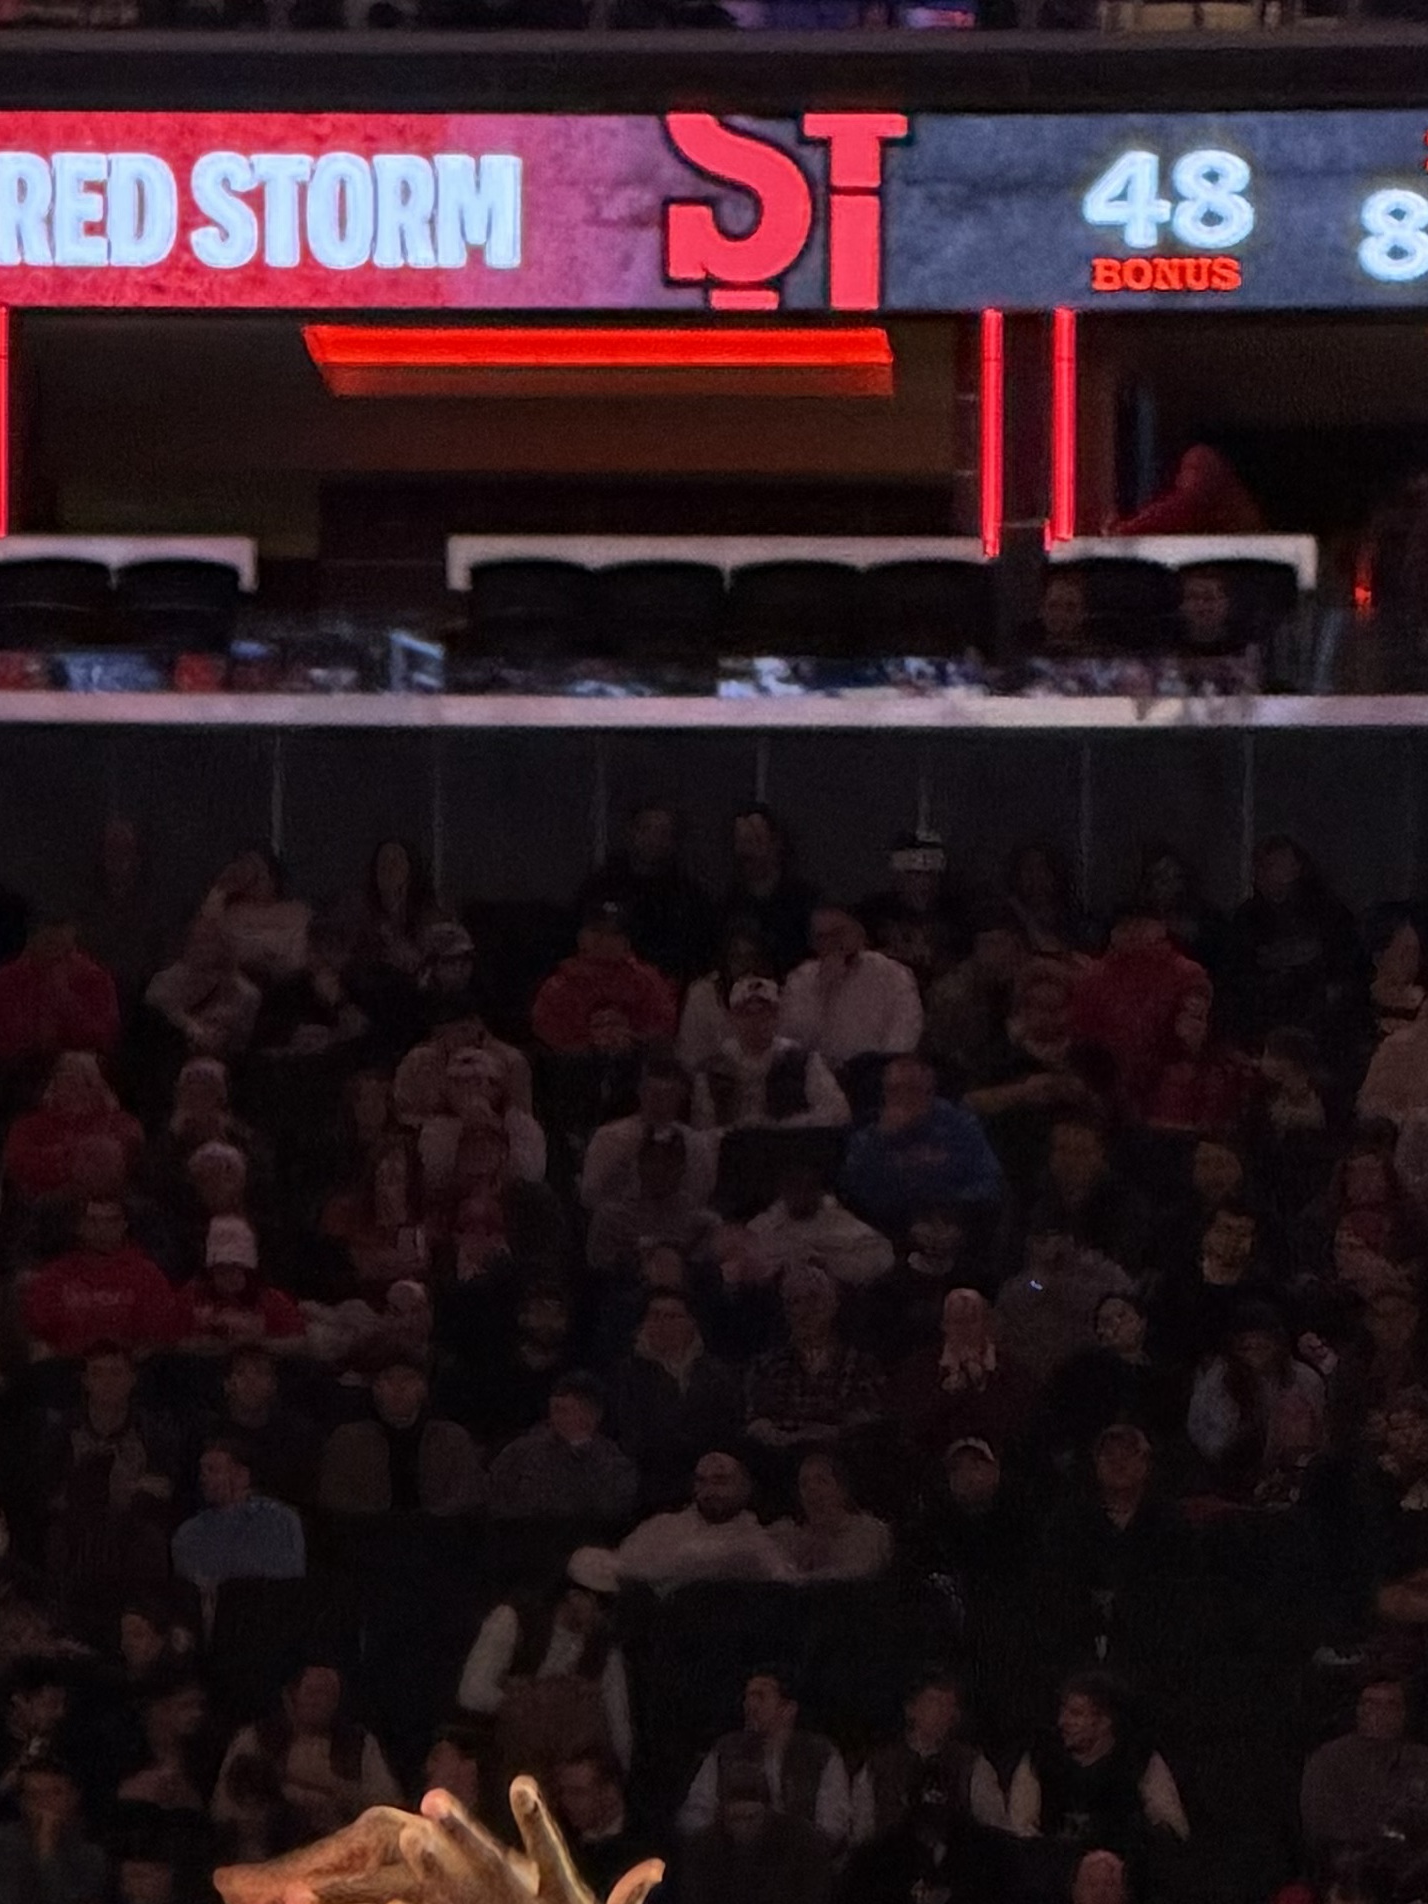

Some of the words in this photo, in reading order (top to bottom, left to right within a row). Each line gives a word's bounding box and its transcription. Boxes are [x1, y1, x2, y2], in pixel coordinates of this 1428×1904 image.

[191, 151, 521, 269] STORM
[1083, 149, 1254, 249] 48
[1092, 257, 1241, 291] BONUS
